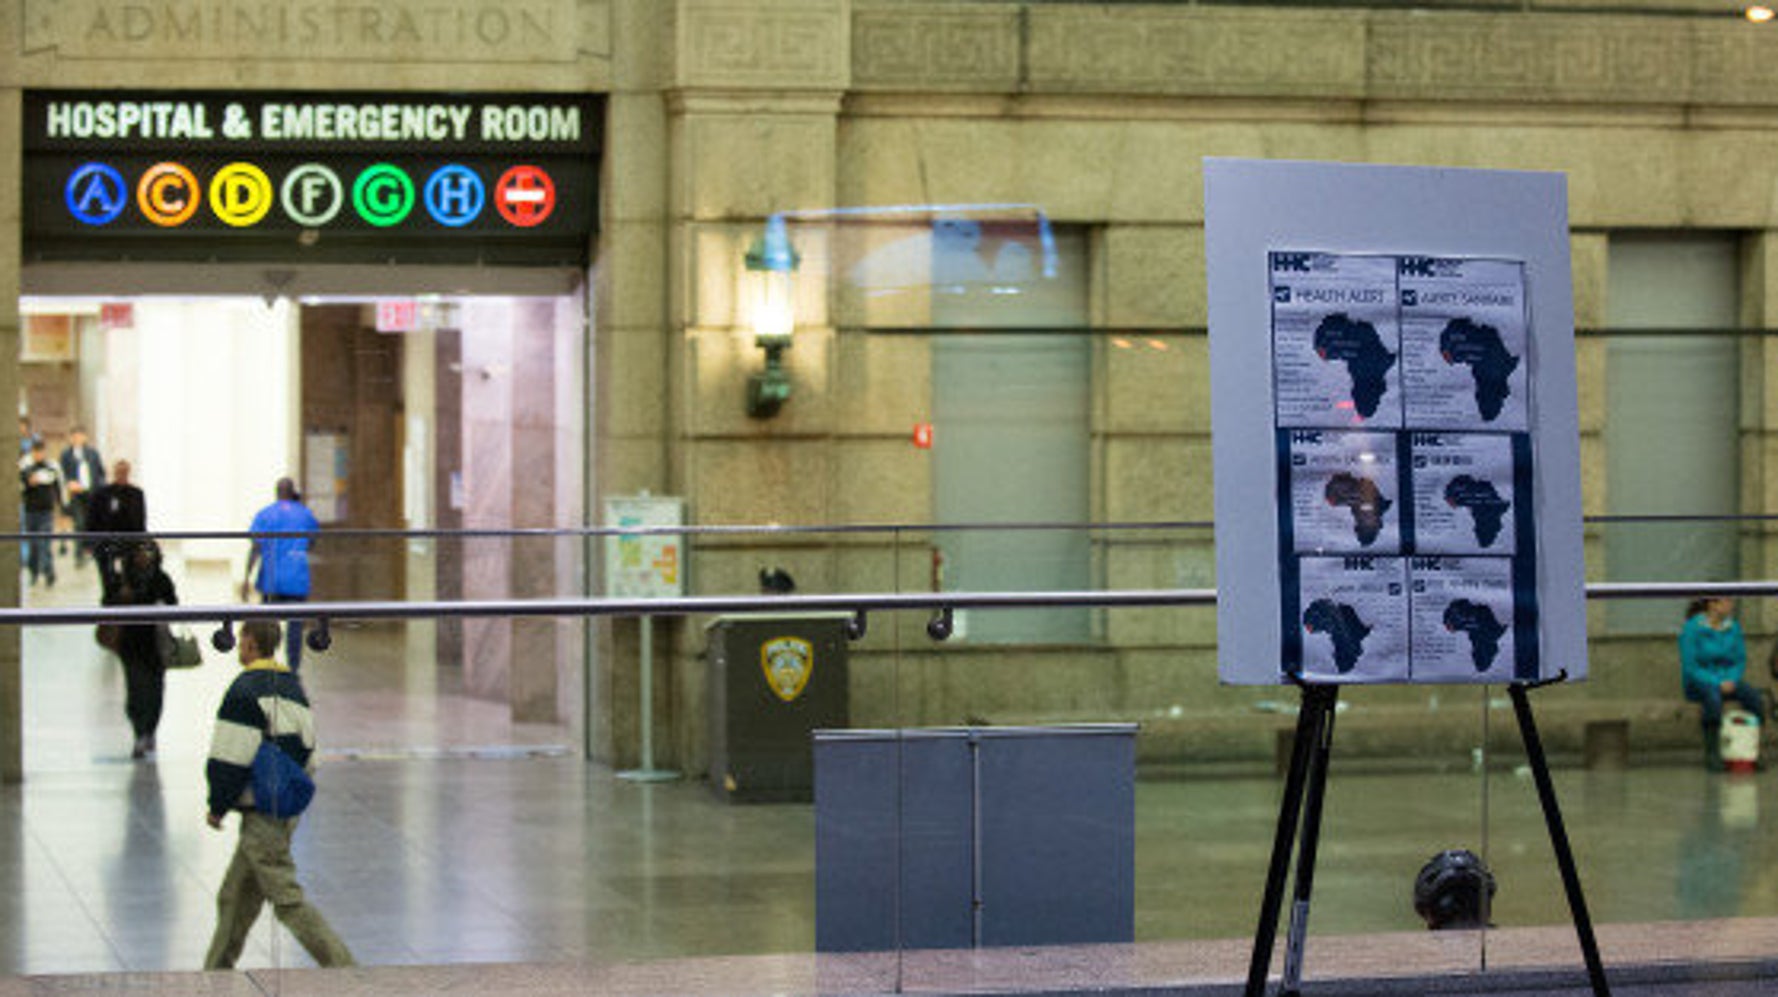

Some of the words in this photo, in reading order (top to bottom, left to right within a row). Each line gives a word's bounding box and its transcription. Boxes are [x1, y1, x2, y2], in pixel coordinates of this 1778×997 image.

[85, 5, 553, 44] ADMINISTRATION
[47, 103, 213, 139] HOSPITAL
[222, 104, 252, 140] &
[261, 105, 470, 141] EMERGENCY
[481, 106, 580, 141] ROOM
